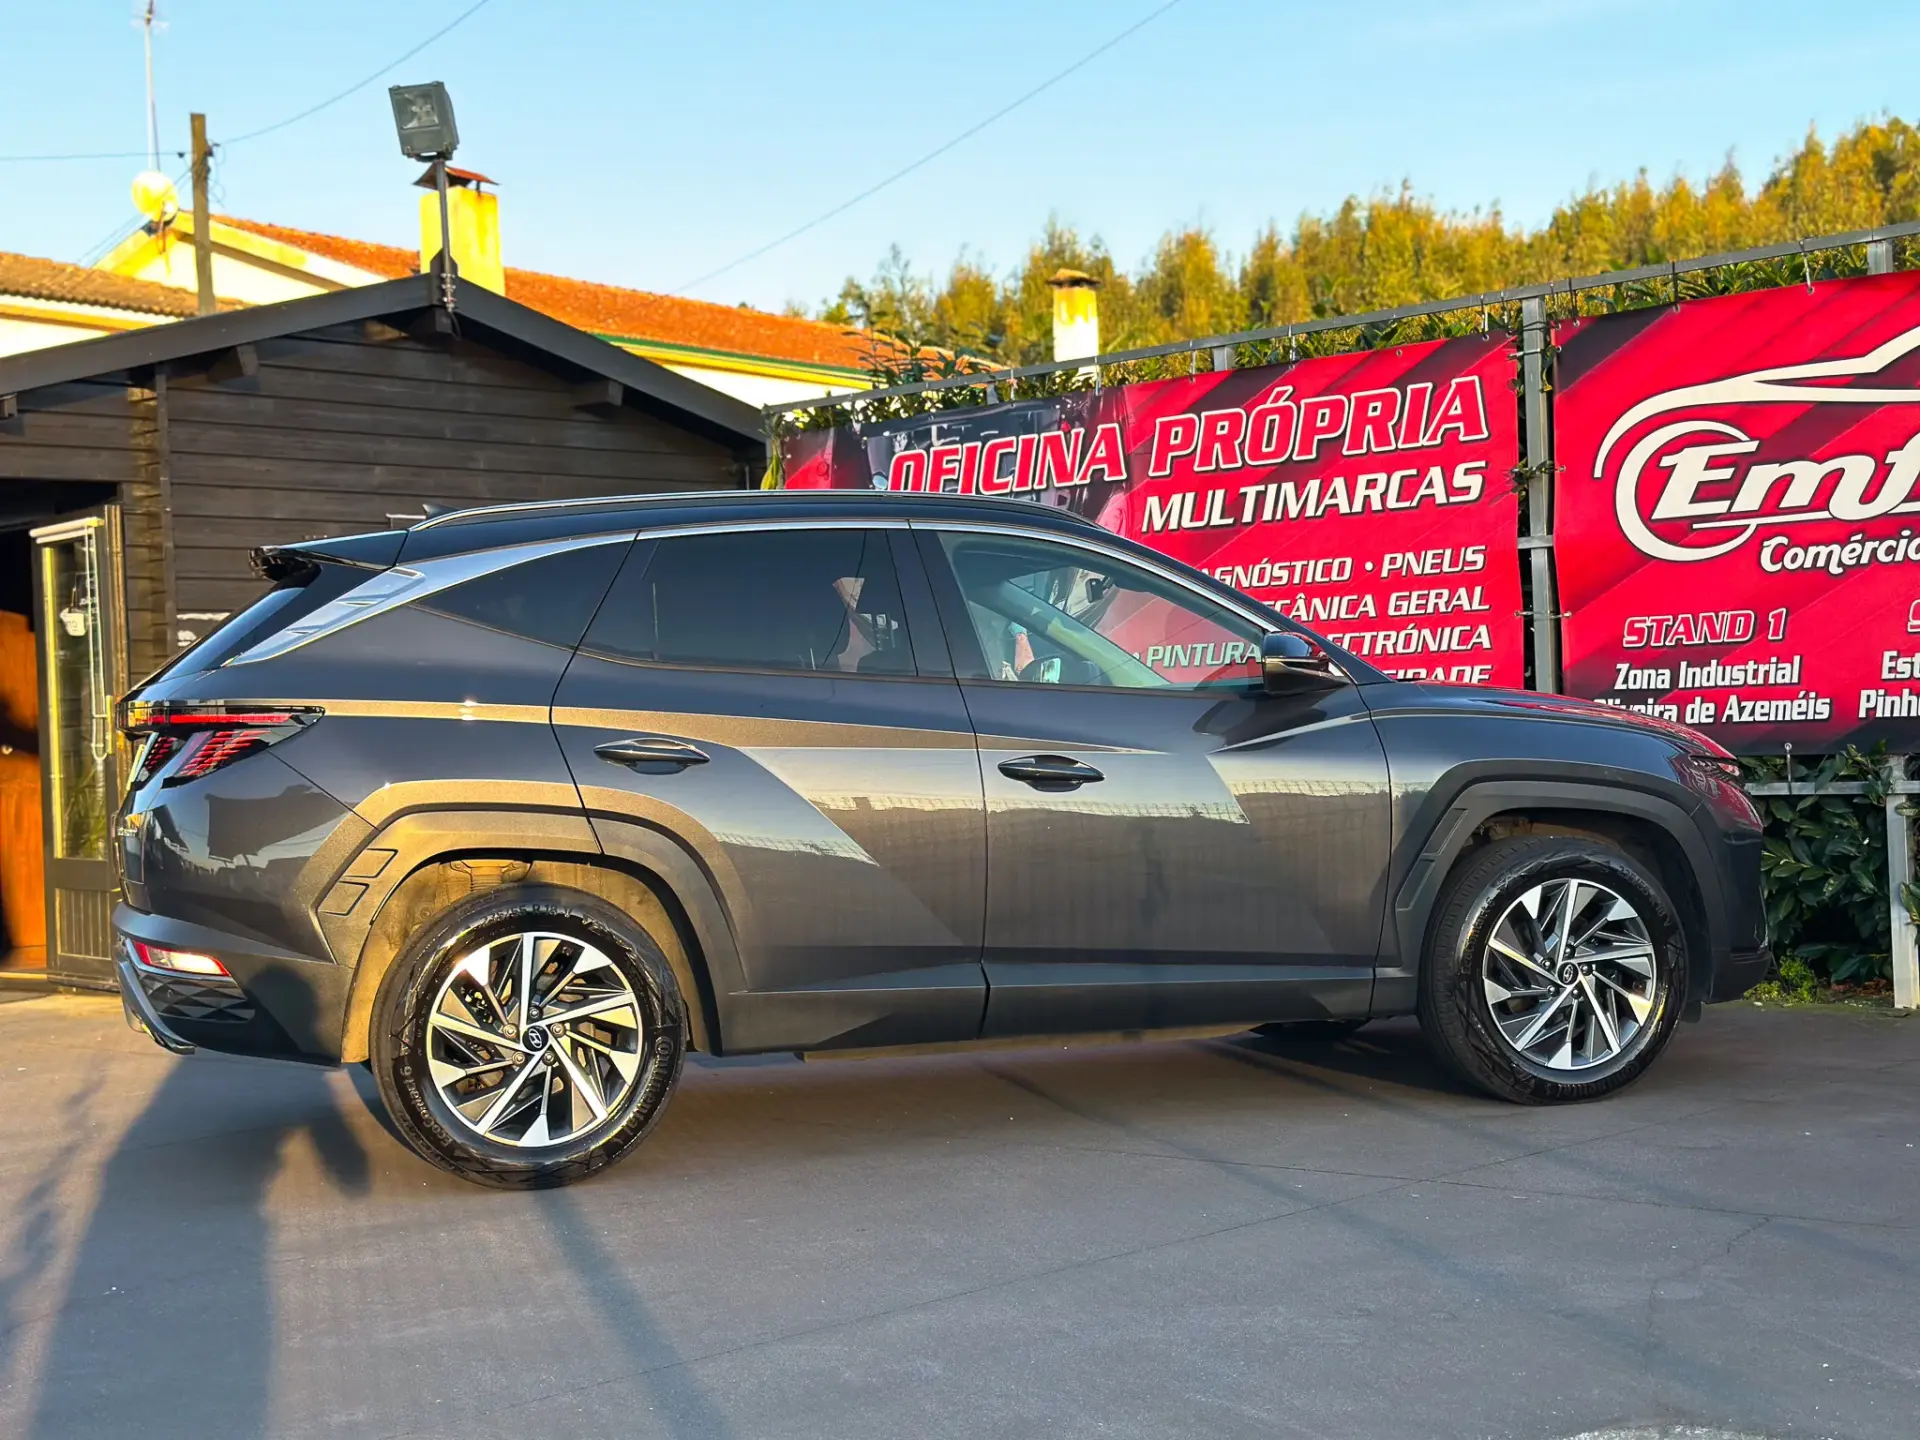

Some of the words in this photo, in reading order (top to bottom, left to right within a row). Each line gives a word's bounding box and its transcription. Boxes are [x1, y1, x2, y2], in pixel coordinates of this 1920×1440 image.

[888, 423, 1127, 495] OFICINA
[1149, 375, 1489, 477] PRÓPRIA
[1141, 460, 1487, 533] MULTIMARCAS
[1201, 557, 1352, 588] GNÓSTICO
[1381, 545, 1486, 578] PNEUS
[1261, 593, 1376, 622] CÂNICA
[1387, 586, 1490, 616] GERAL
[1623, 609, 1754, 648] STAND
[1768, 608, 1787, 640] 1
[1614, 663, 1671, 690] Zona
[1678, 655, 1801, 689] Industrial
[1685, 696, 1716, 725] de
[1722, 691, 1831, 723] Azeméis
[1858, 688, 1920, 718] Pinh
